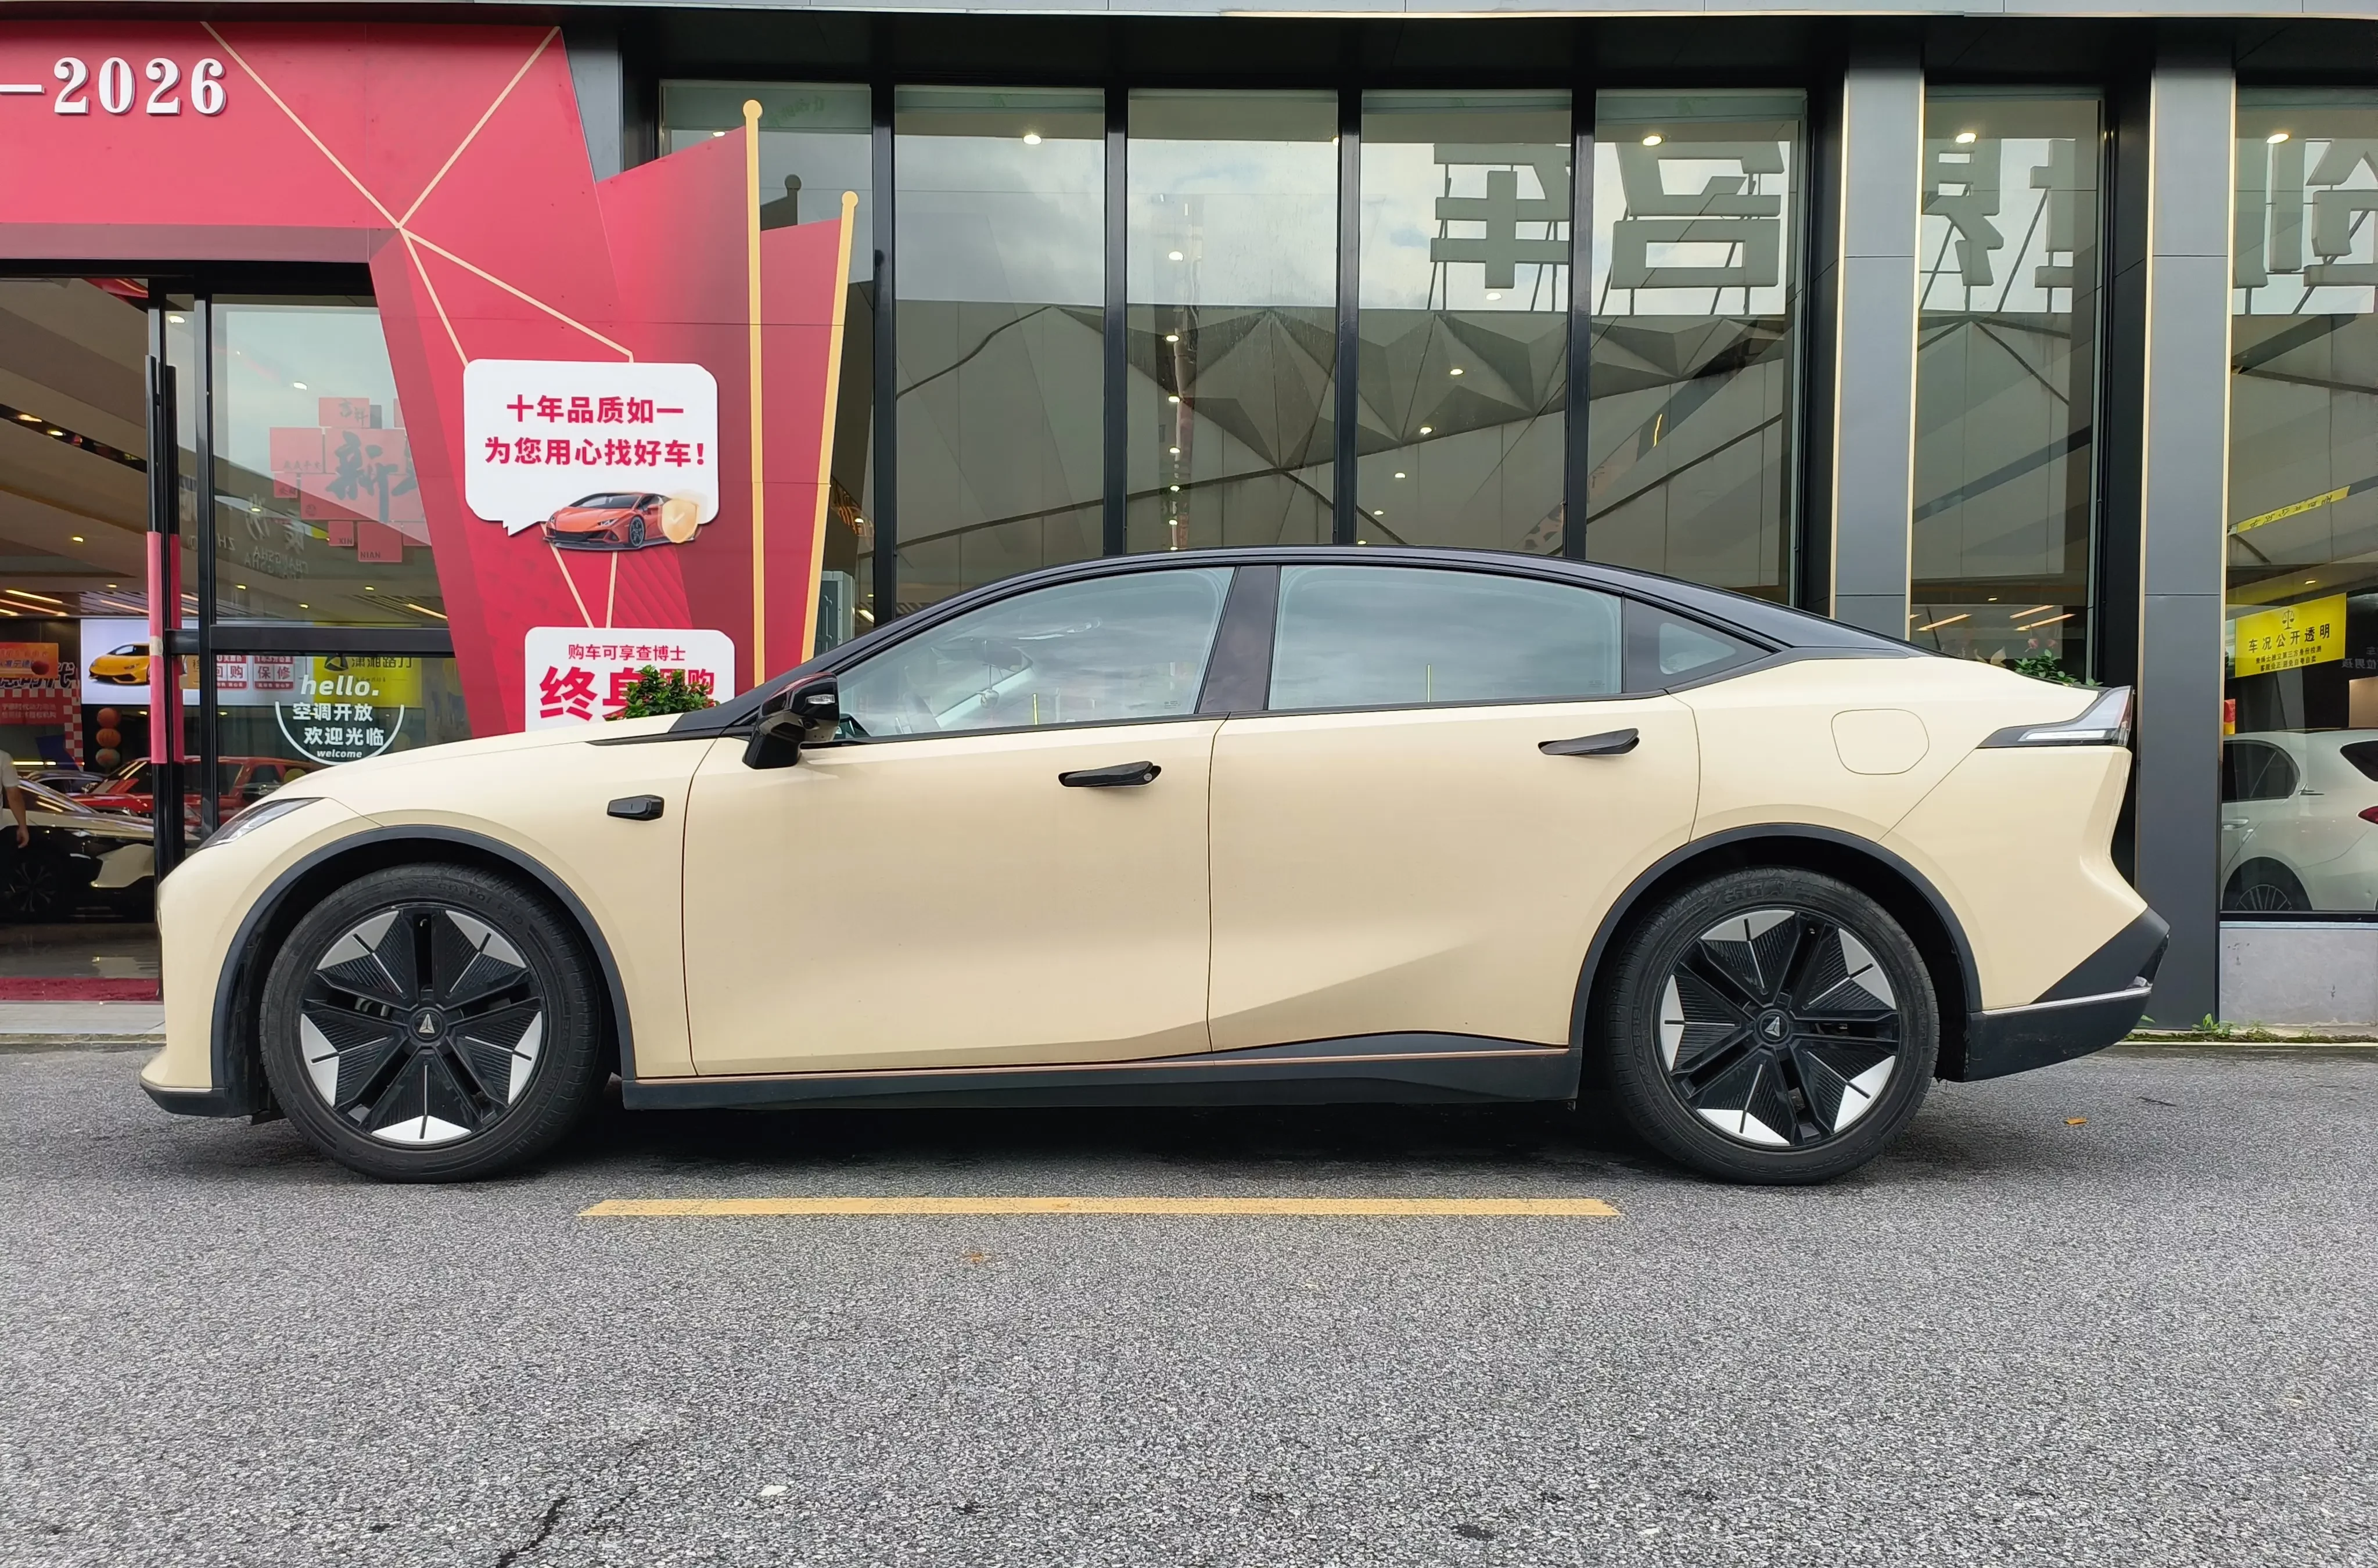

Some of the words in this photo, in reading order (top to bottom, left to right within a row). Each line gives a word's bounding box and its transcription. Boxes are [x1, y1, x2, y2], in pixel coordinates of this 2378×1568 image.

[507, 394, 684, 424] 十年品质如一
[484, 436, 705, 467] 为您用心找好车!
[2248, 623, 2330, 654] 车况公开透明
[568, 643, 686, 661] 购车可享查博士
[257, 666, 291, 679] 保修
[300, 674, 379, 696] hello.
[292, 702, 373, 722] 空调开放
[303, 727, 385, 747] 欢迎光临
[317, 749, 362, 758] welcome
